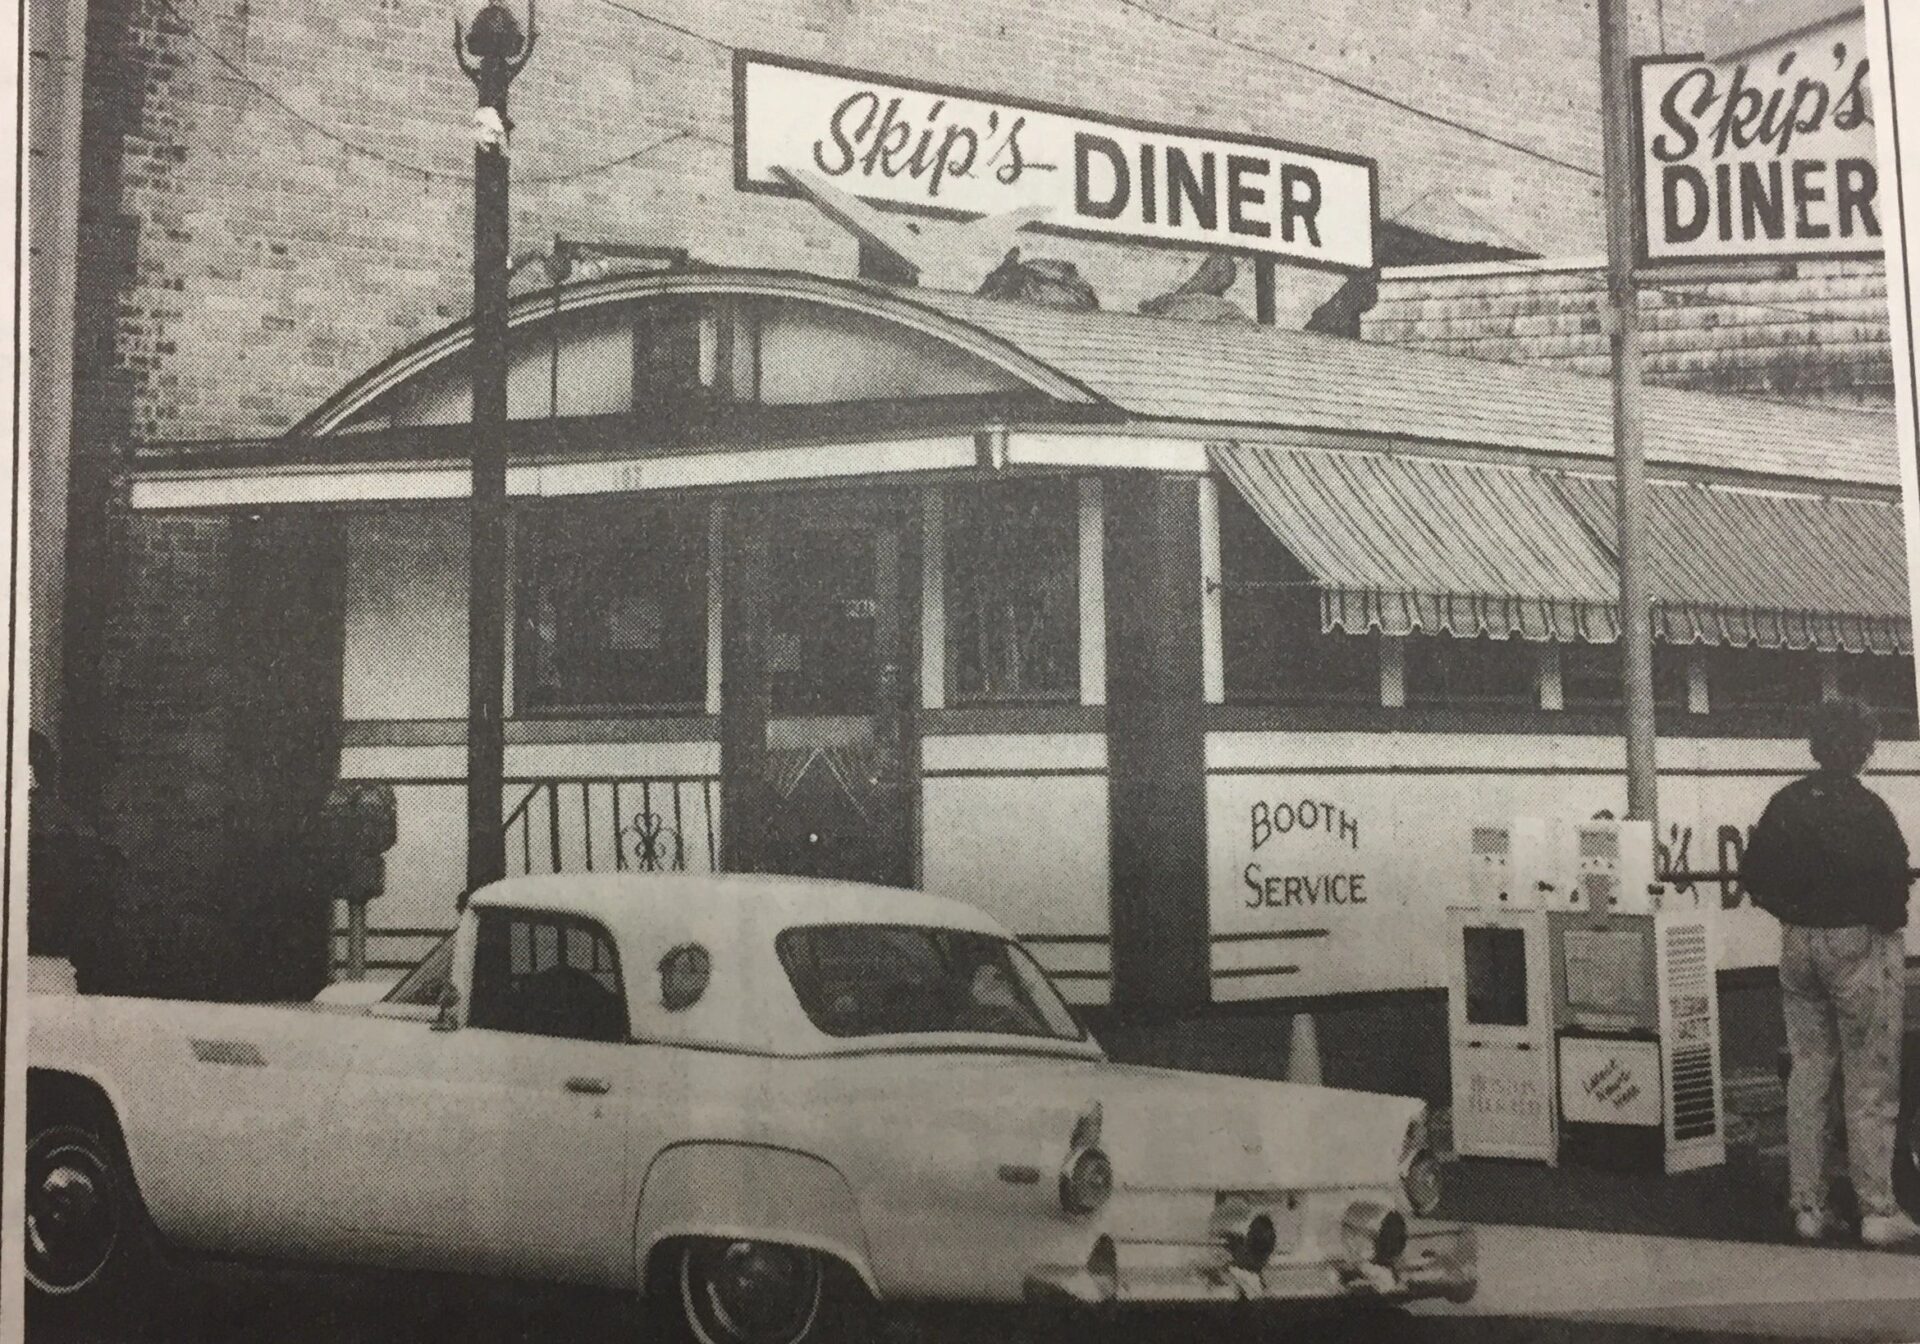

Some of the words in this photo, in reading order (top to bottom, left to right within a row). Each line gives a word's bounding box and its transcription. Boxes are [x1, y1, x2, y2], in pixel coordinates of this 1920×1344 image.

[1650, 42, 1876, 163] Skip's
[813, 90, 1057, 197] Skip's
[1074, 131, 1323, 248] DINER
[1661, 157, 1883, 244] DINER
[1250, 799, 1359, 851] BOOTH
[1243, 862, 1368, 909] SERVICE
